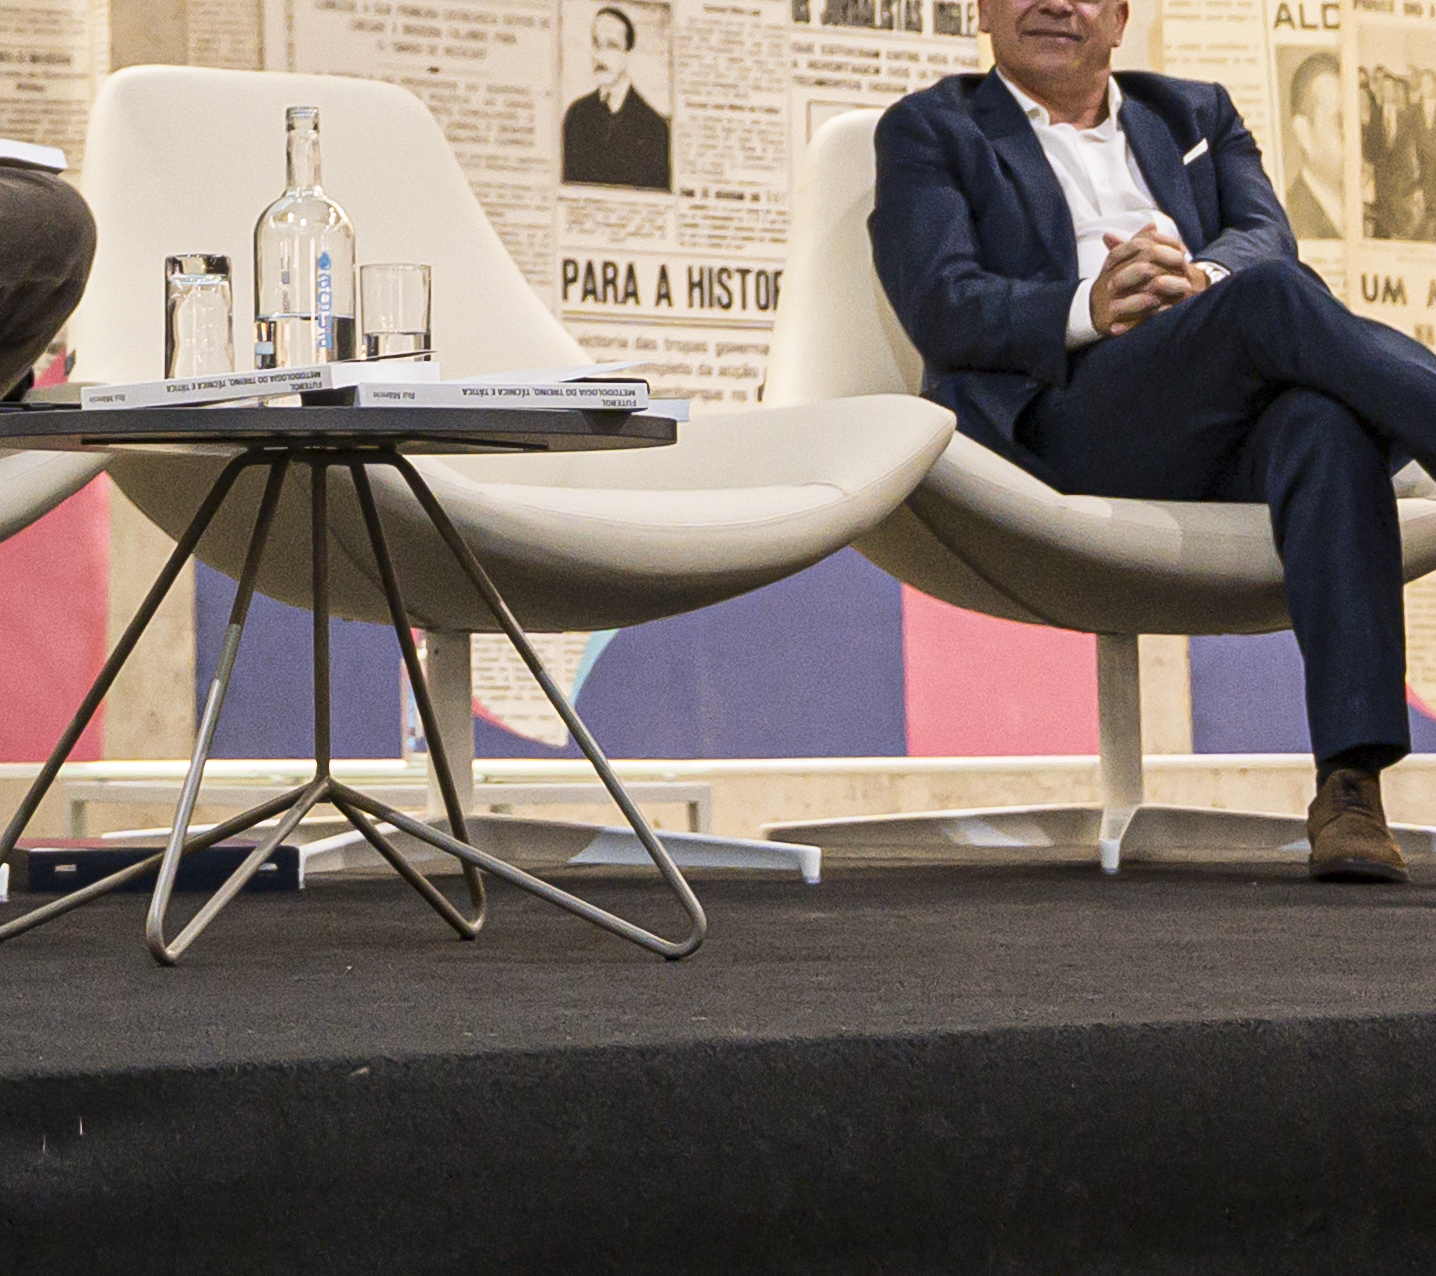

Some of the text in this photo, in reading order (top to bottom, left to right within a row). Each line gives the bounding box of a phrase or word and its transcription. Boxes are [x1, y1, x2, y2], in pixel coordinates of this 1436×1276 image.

[562, 257, 641, 307] PARA
[654, 264, 673, 308] A
[1360, 272, 1407, 305] UM
